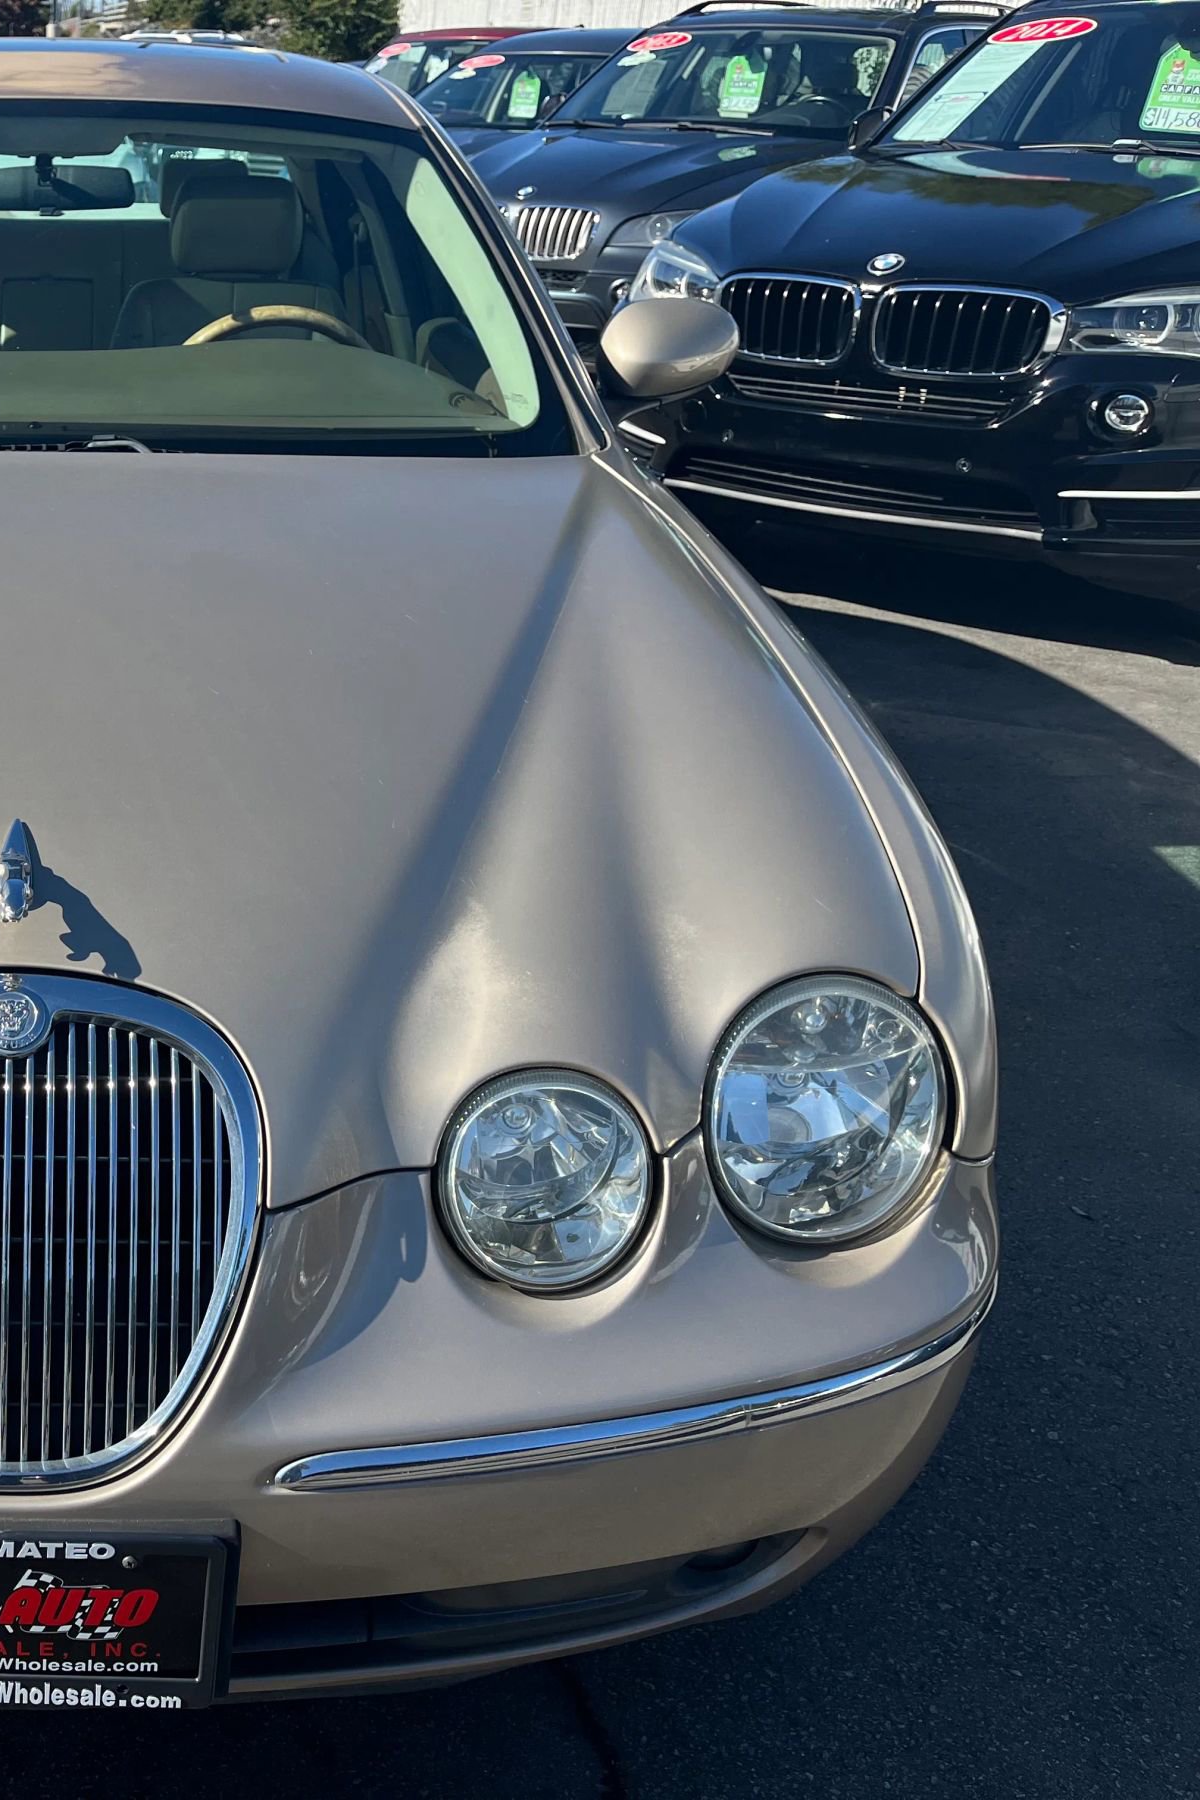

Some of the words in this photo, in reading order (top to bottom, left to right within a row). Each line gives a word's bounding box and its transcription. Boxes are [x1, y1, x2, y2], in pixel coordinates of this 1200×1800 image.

[999, 20, 1085, 41] 2014
[1143, 107, 1200, 129] $14,58
[0, 1587, 160, 1628] AUTO
[90, 1642, 161, 1658] INC.
